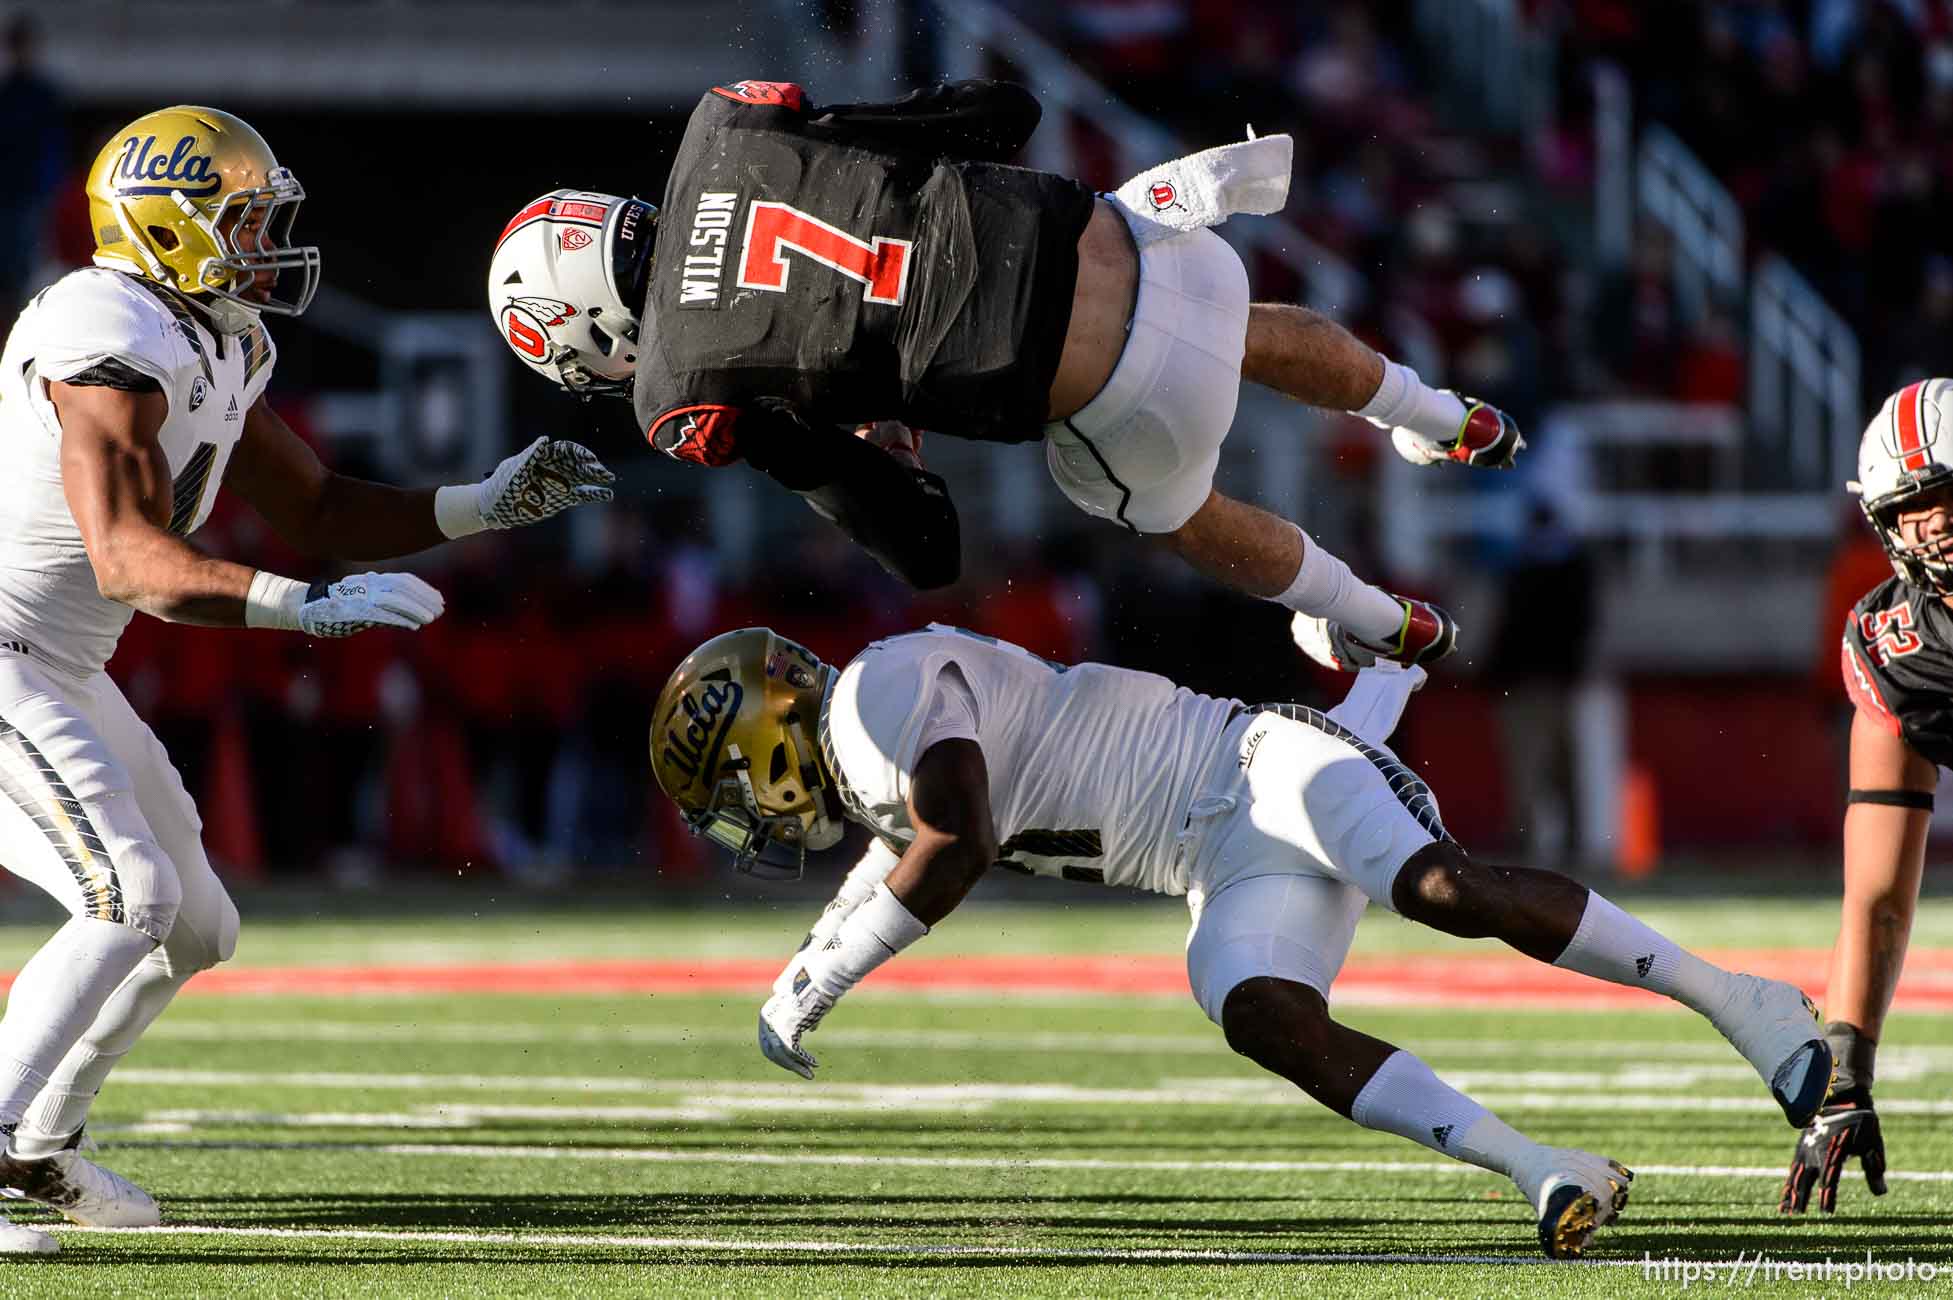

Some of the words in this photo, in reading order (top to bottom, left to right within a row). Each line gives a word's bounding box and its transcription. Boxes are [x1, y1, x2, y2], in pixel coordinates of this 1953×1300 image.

[117, 135, 222, 198] Ucla
[1152, 186, 1174, 205] U
[621, 203, 645, 241] UTES
[680, 192, 738, 305] WILSON
[736, 200, 912, 306] 7
[509, 311, 545, 358] U
[1859, 600, 1924, 667] 52
[664, 681, 743, 789] Ucla
